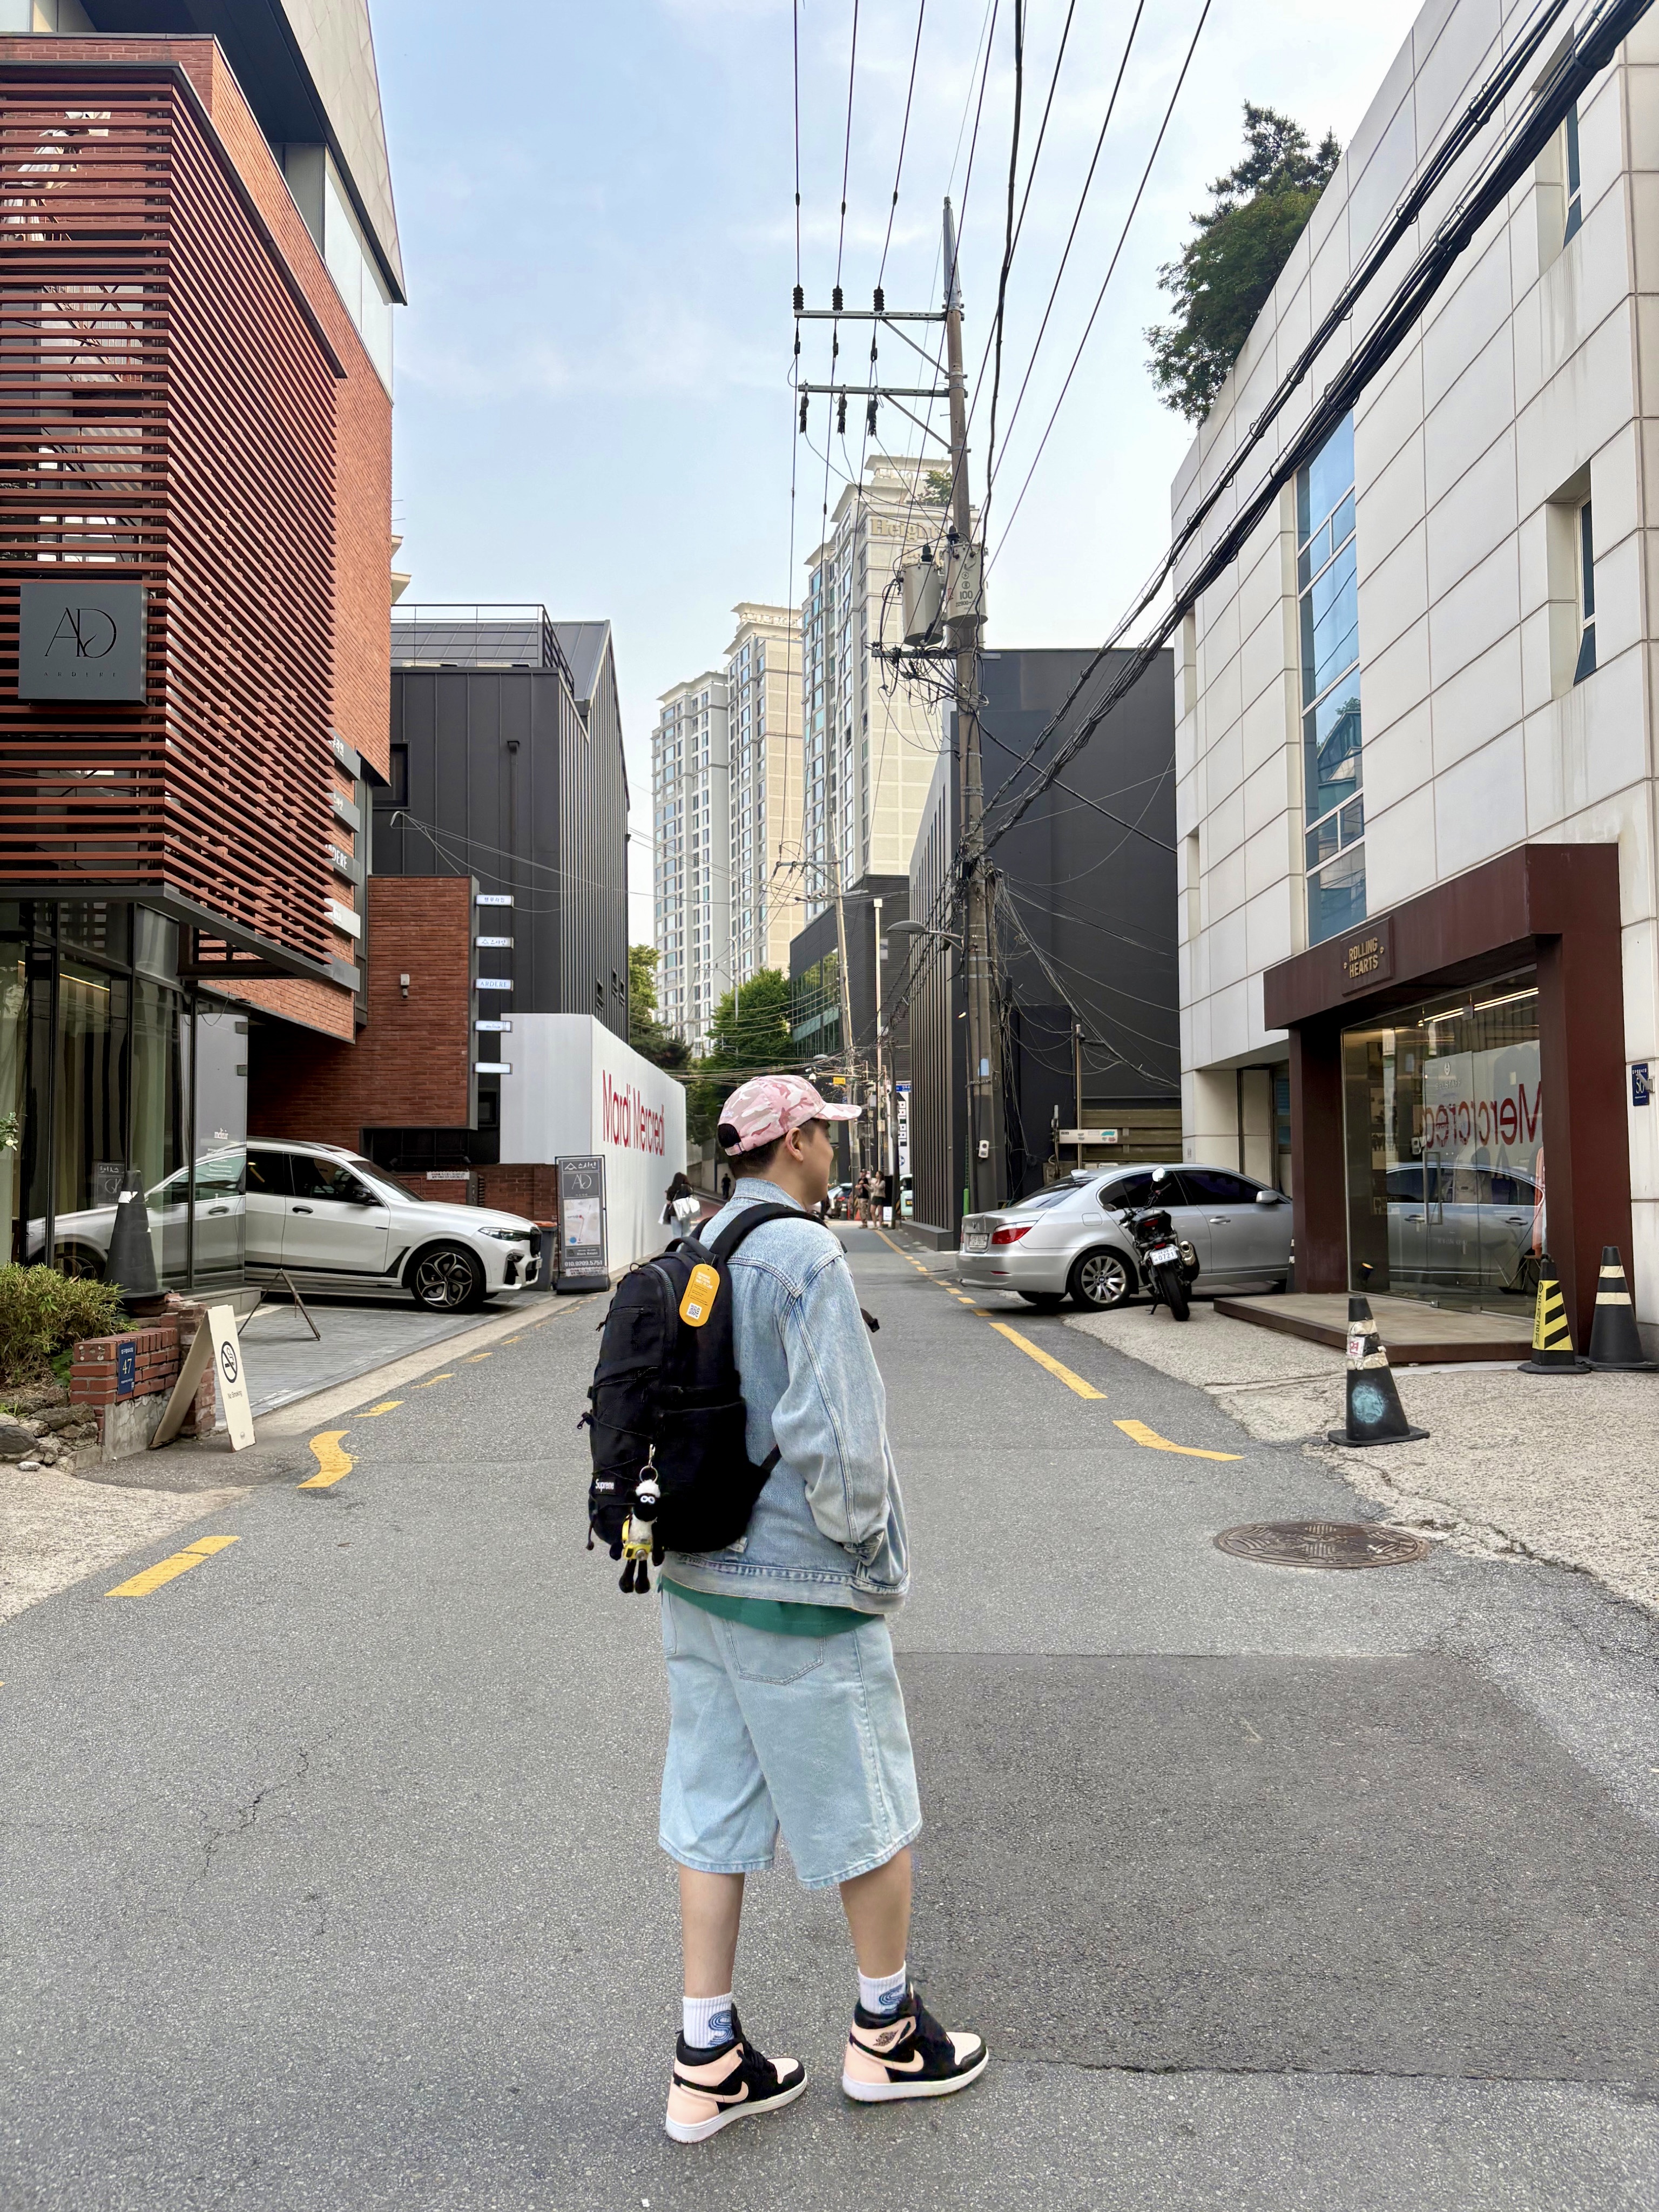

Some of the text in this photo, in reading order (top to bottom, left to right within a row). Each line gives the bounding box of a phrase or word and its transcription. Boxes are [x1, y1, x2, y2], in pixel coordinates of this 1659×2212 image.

[960, 590, 973, 600] 100
[1349, 937, 1378, 962] ROLLING
[1350, 954, 1378, 978] HEARTS
[603, 1069, 665, 1156] Mardi Mercredi
[1158, 1252, 1174, 1260] 0721
[123, 1358, 132, 1374] 47
[595, 1479, 615, 1492] Supreme
